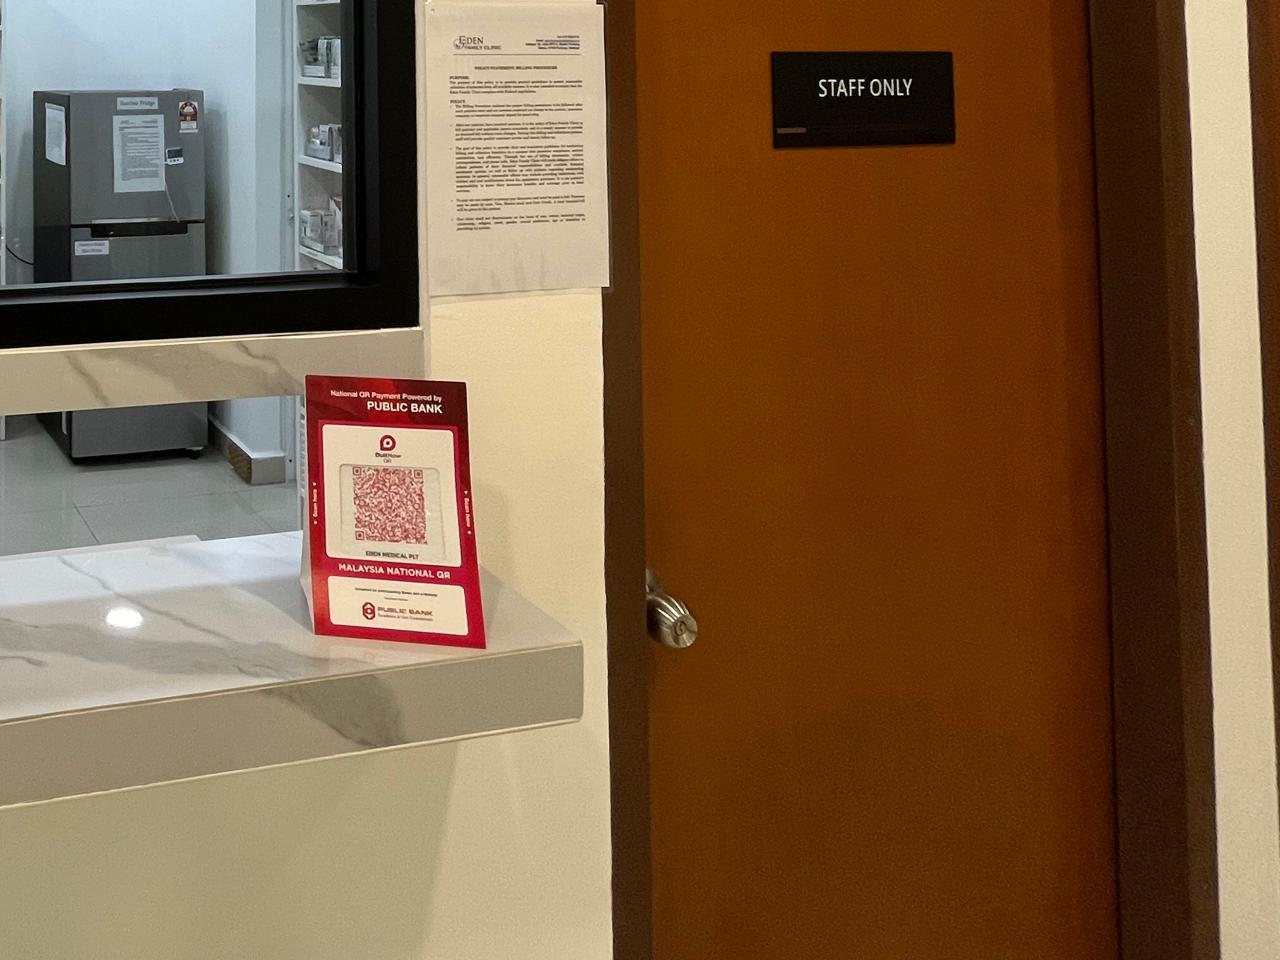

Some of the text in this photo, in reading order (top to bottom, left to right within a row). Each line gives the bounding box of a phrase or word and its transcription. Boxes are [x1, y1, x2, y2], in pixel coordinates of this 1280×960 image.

[818, 78, 913, 98] STAFF ONLY
[330, 390, 358, 398] National
[371, 392, 401, 400] Payment
[402, 393, 432, 401] Powered
[433, 394, 442, 403] by
[367, 401, 443, 414] PUBLIC BANK
[382, 551, 408, 559] MEDICAL
[339, 563, 451, 579] MALAYSIA NATIONAL QR
[377, 606, 407, 614] PUBLIC
